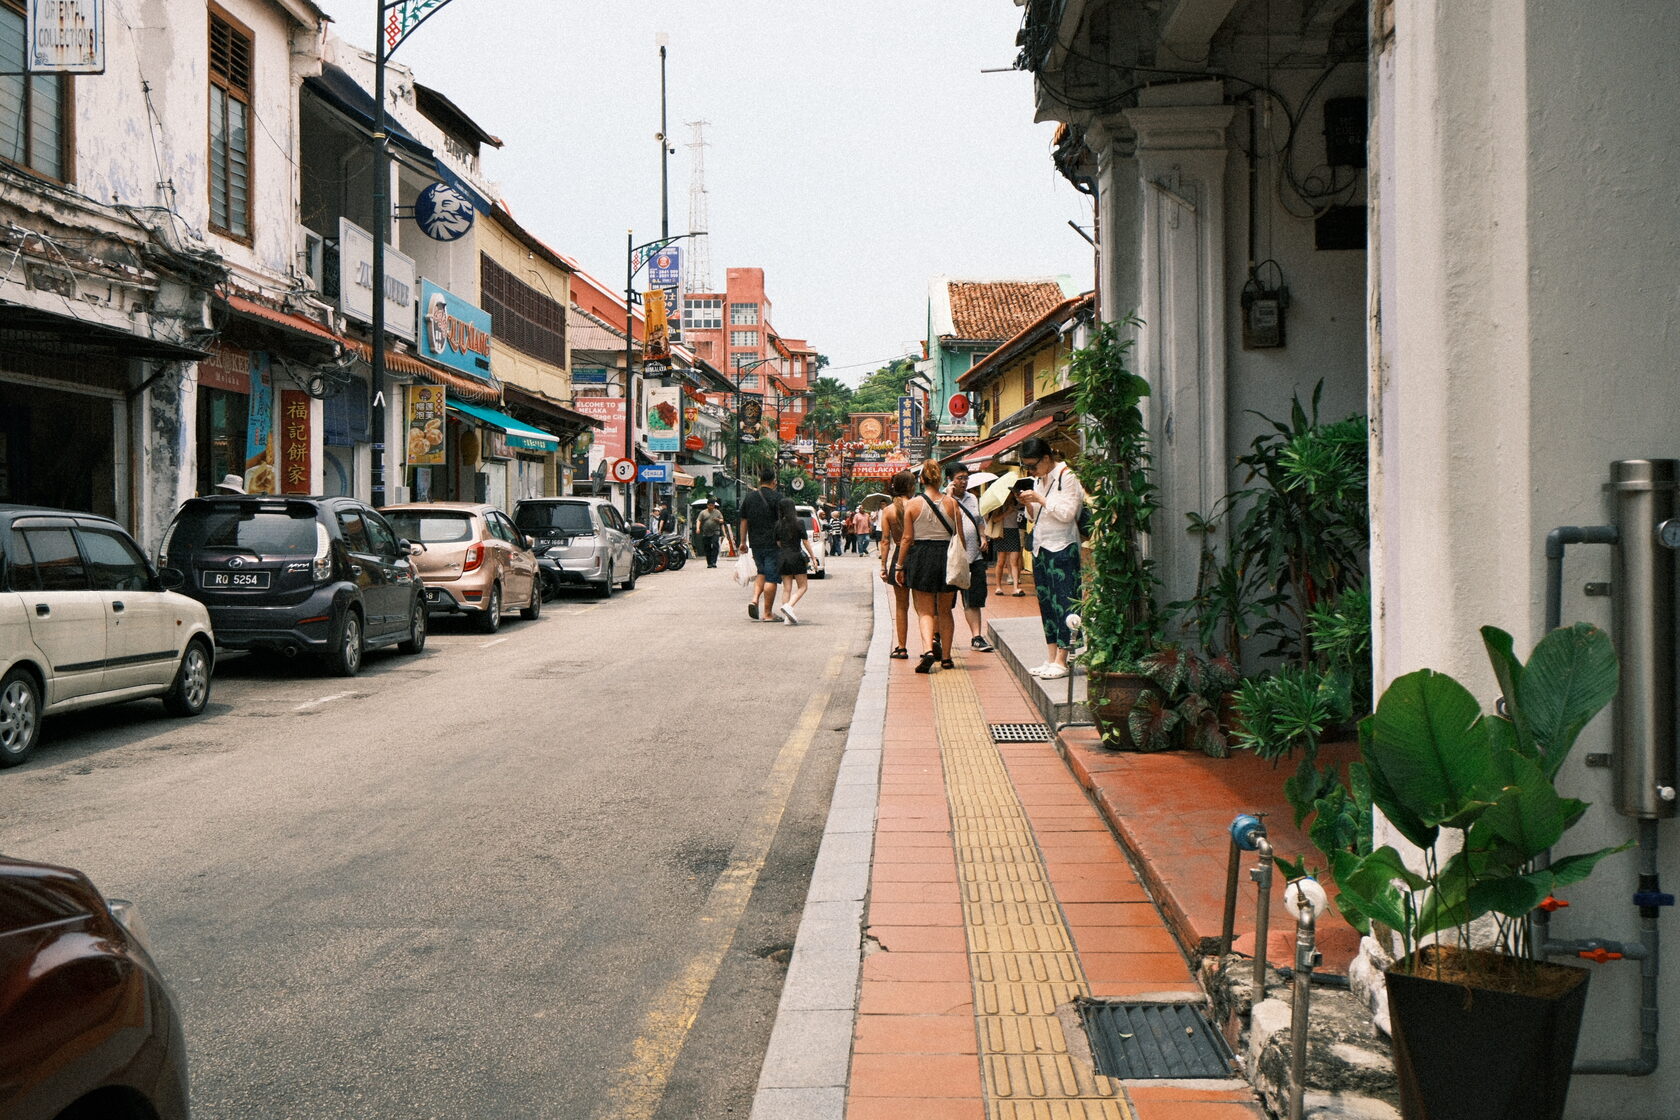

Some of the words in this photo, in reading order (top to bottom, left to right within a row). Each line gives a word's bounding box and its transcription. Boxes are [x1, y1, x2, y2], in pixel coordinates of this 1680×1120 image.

[44, 0, 86, 20] ORIENTAL
[39, 28, 94, 48] COLLECTIONS
[287, 401, 308, 485] 福記餅家
[233, 574, 258, 585] 5254
